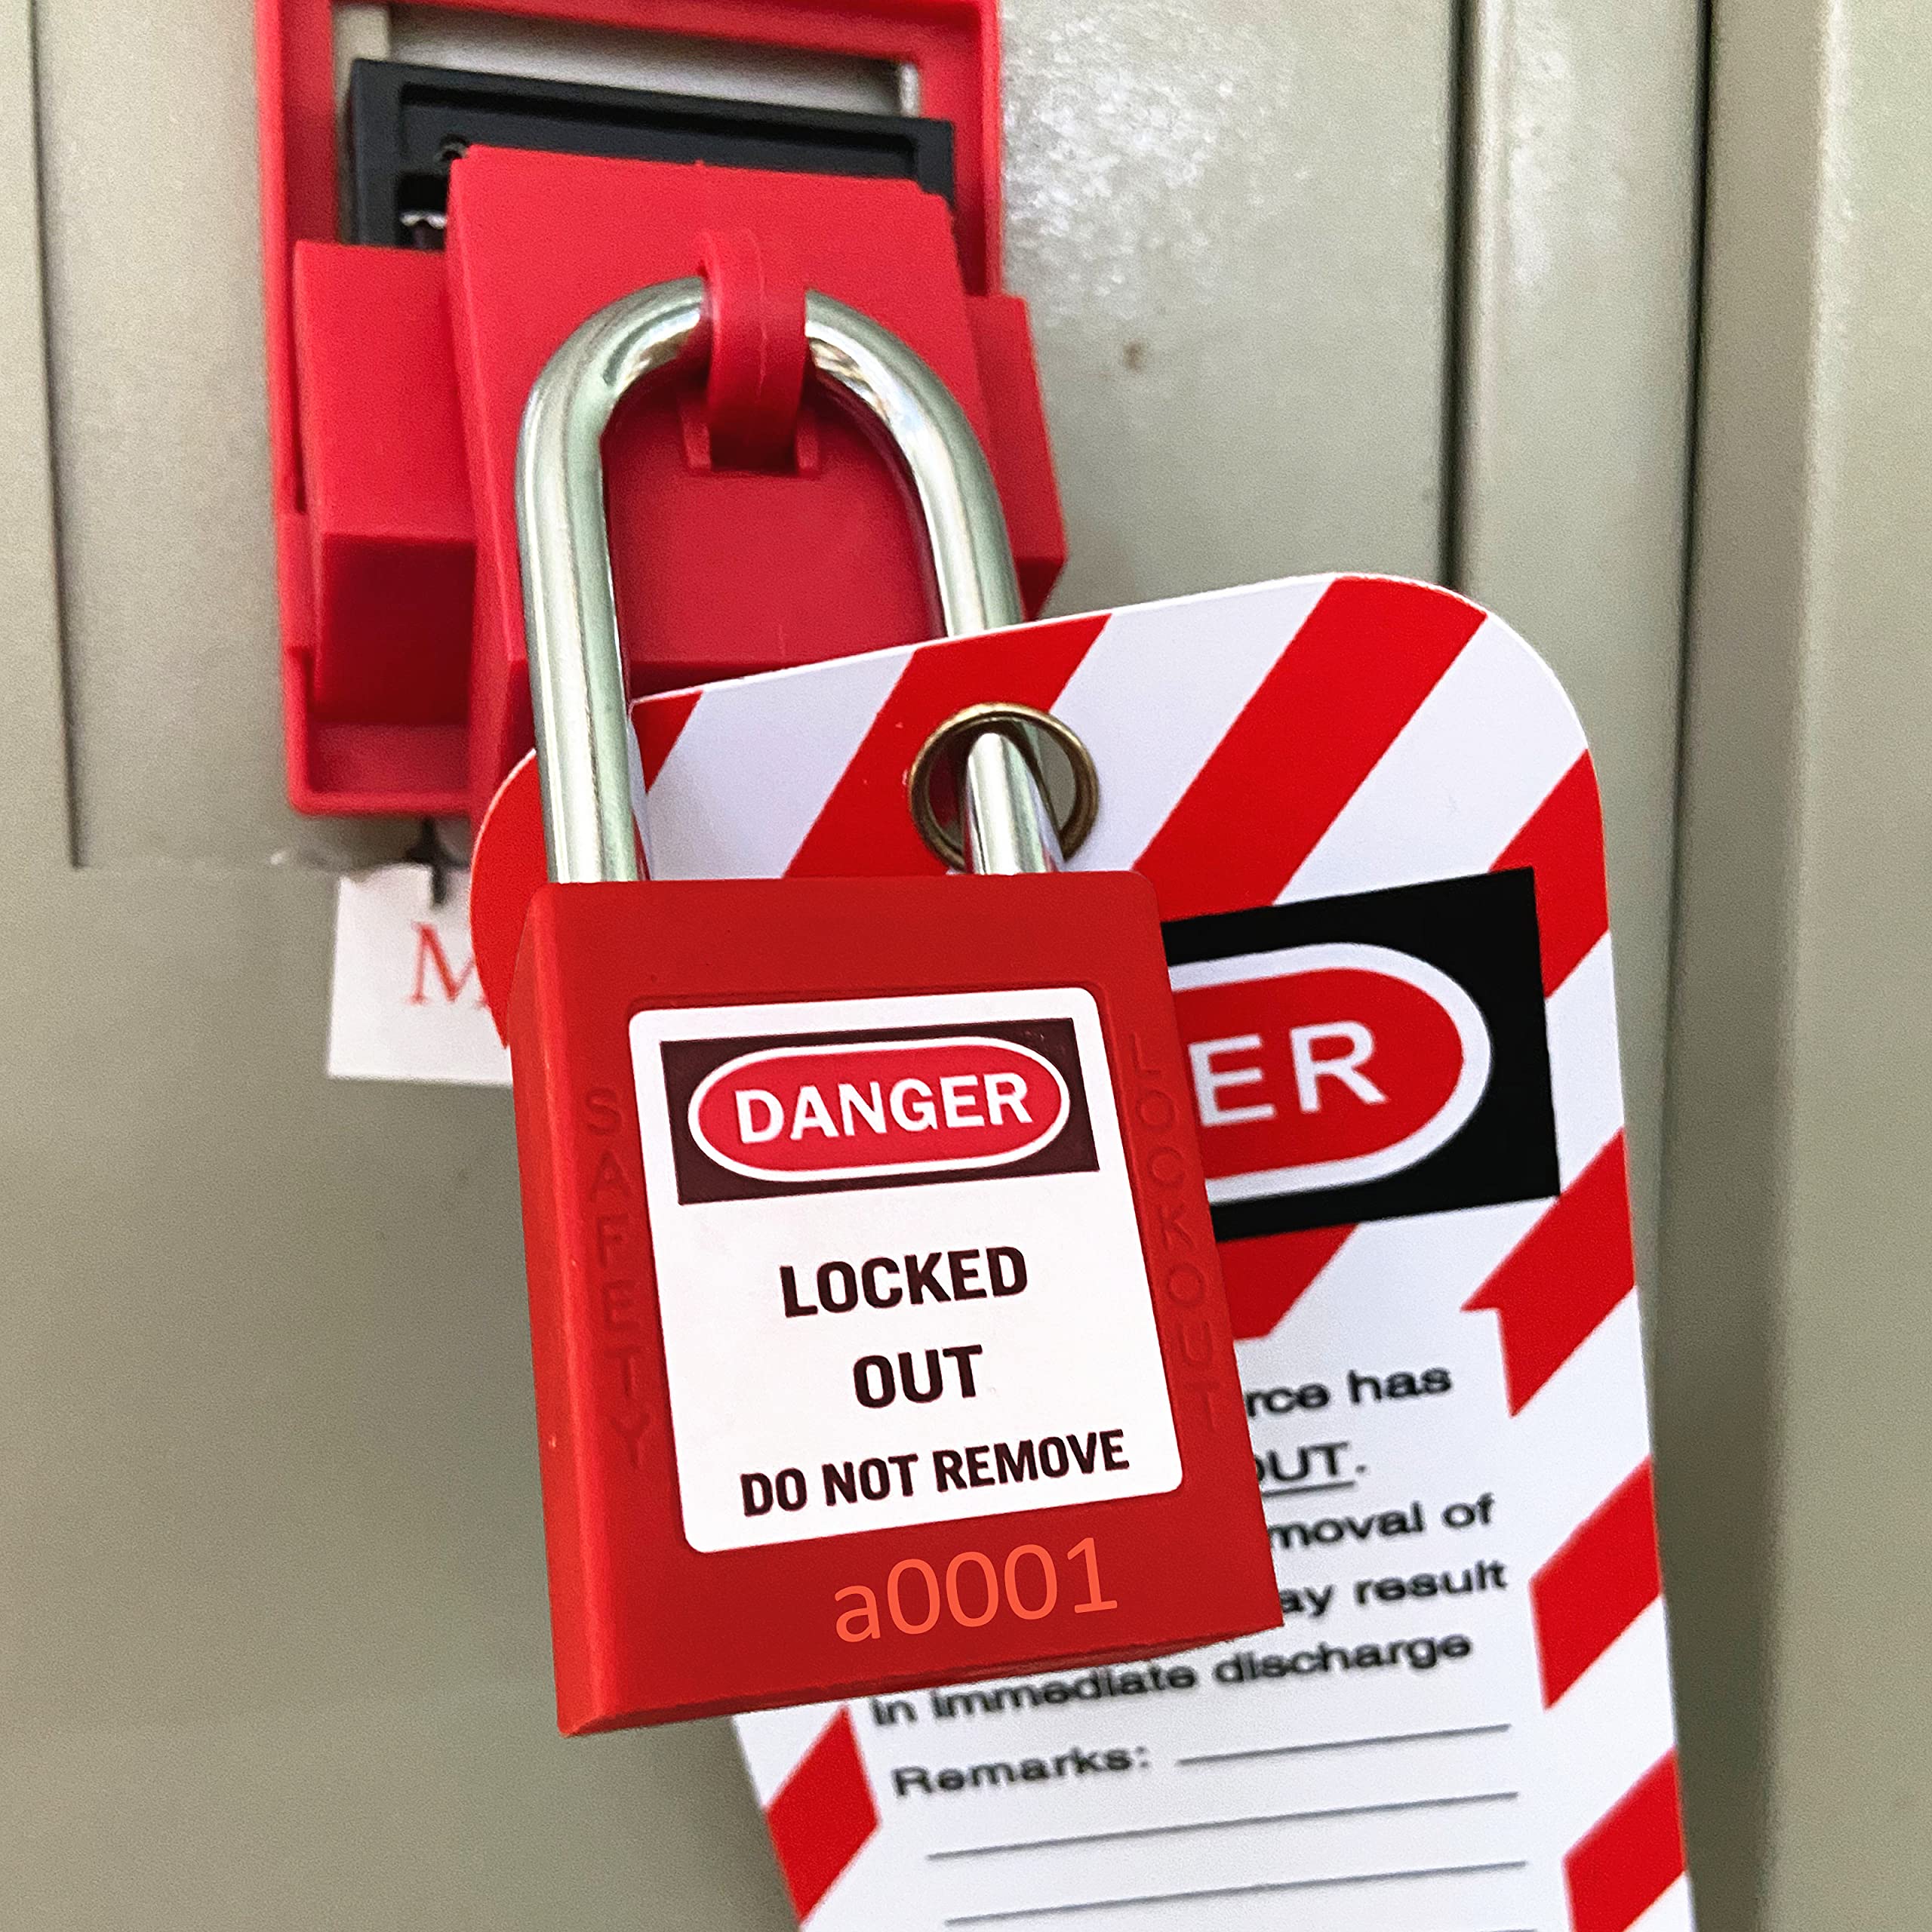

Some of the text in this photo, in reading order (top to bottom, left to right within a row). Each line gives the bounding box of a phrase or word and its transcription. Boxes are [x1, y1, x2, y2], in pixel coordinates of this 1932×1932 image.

[735, 1072, 1033, 1144] DANGER
[1129, 1032, 1220, 1433] LOCKOUT
[584, 1087, 651, 1471] SAFETY
[780, 1246, 1028, 1318] LOCKED
[853, 1344, 983, 1408] OUT
[1346, 1367, 1454, 1406] has
[740, 1429, 1130, 1517] DO NOT REMOVE
[1441, 1491, 1494, 1529] of
[834, 1537, 1118, 1643] a0001
[1353, 1559, 1508, 1606] result
[929, 1661, 1198, 1719] immediate
[1212, 1633, 1474, 1684] discharge
[890, 1744, 1149, 1798] Remarks:
